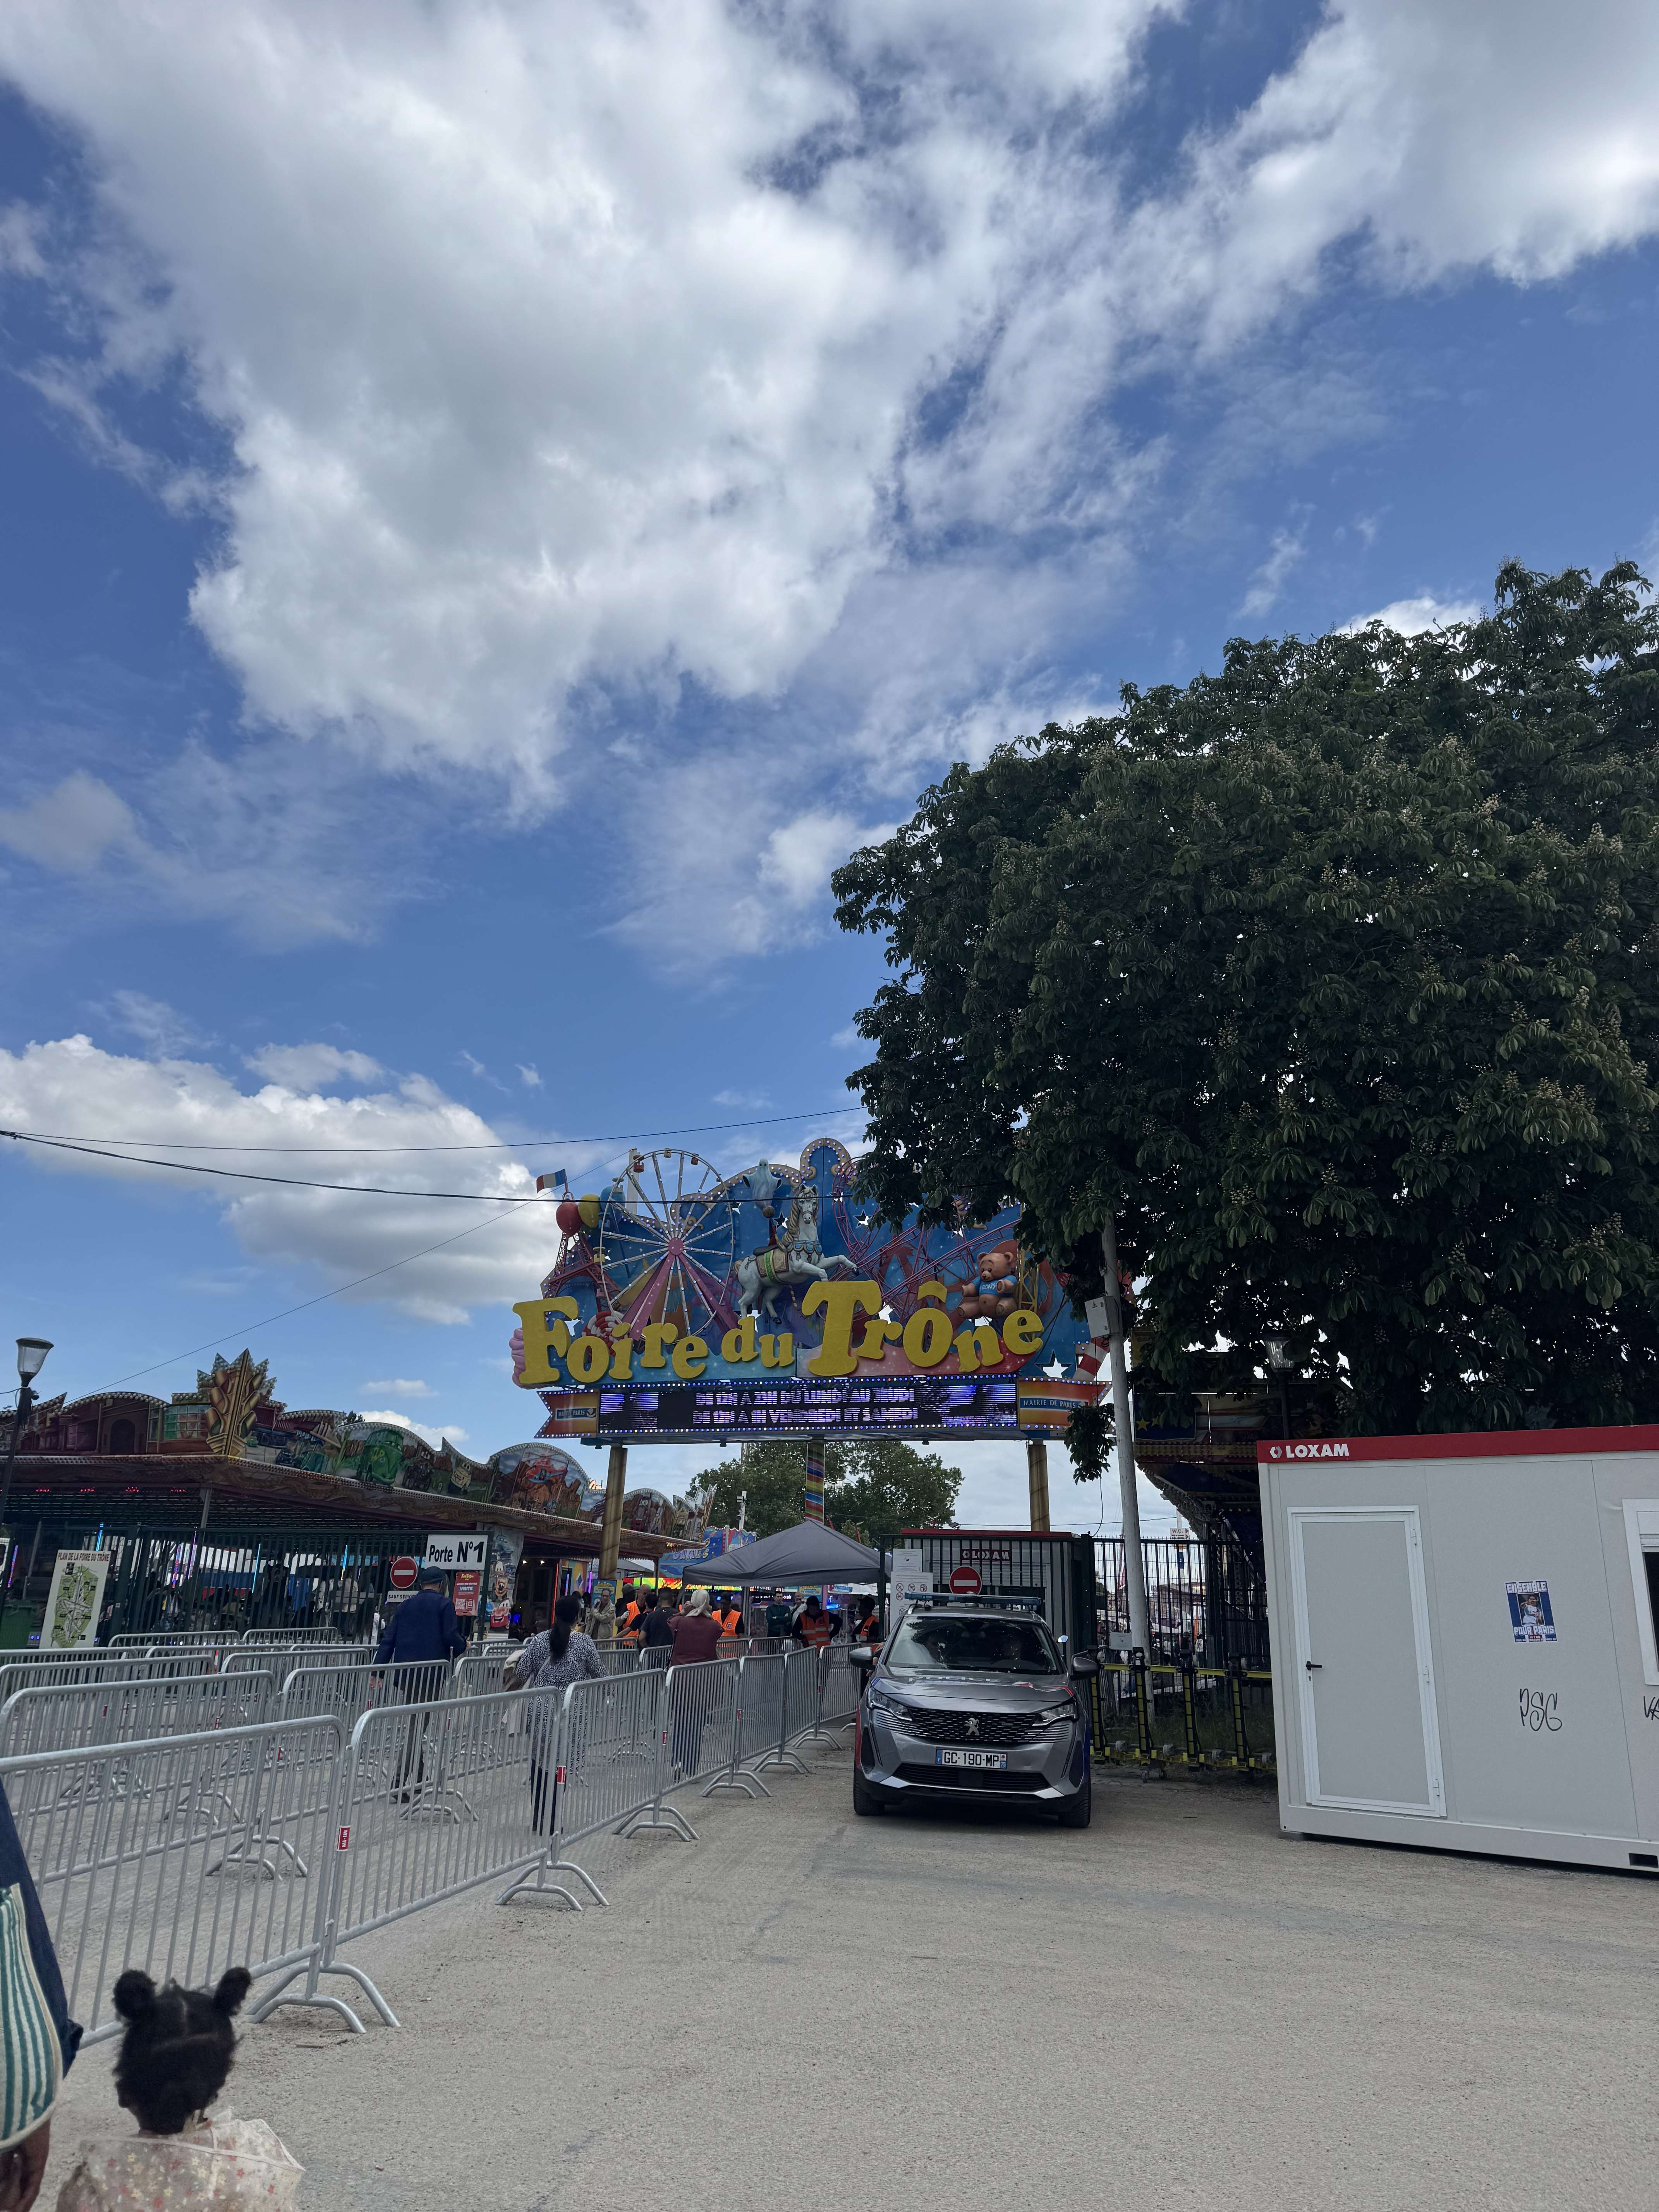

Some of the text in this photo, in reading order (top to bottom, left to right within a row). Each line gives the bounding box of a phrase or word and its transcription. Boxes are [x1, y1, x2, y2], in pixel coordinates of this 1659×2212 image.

[512, 1280, 1044, 1384] Foire du Trône
[696, 1393, 713, 1405] DE
[716, 1392, 737, 1405] 12H
[740, 1392, 752, 1405] A
[780, 1390, 801, 1404] DU
[804, 1389, 847, 1403] LUNDI
[850, 1388, 870, 1402] AU
[873, 1387, 914, 1402] JEUDI
[693, 1410, 710, 1424] DE
[713, 1410, 735, 1423] 12H
[737, 1410, 749, 1423] A
[769, 1408, 841, 1423] VENDREDI
[844, 1408, 860, 1422] ET
[862, 1407, 919, 1421] SAMEDI
[1286, 1444, 1350, 1458] LOXAM
[428, 1541, 484, 1563] Porte N°1
[972, 1551, 1009, 1560] LOXAM
[1506, 1581, 1548, 1594] ENSEMBLE
[1514, 1625, 1555, 1636] POUR PARIS
[1520, 1688, 1562, 1731] PSG
[944, 1752, 999, 1767] GC-190-MP
